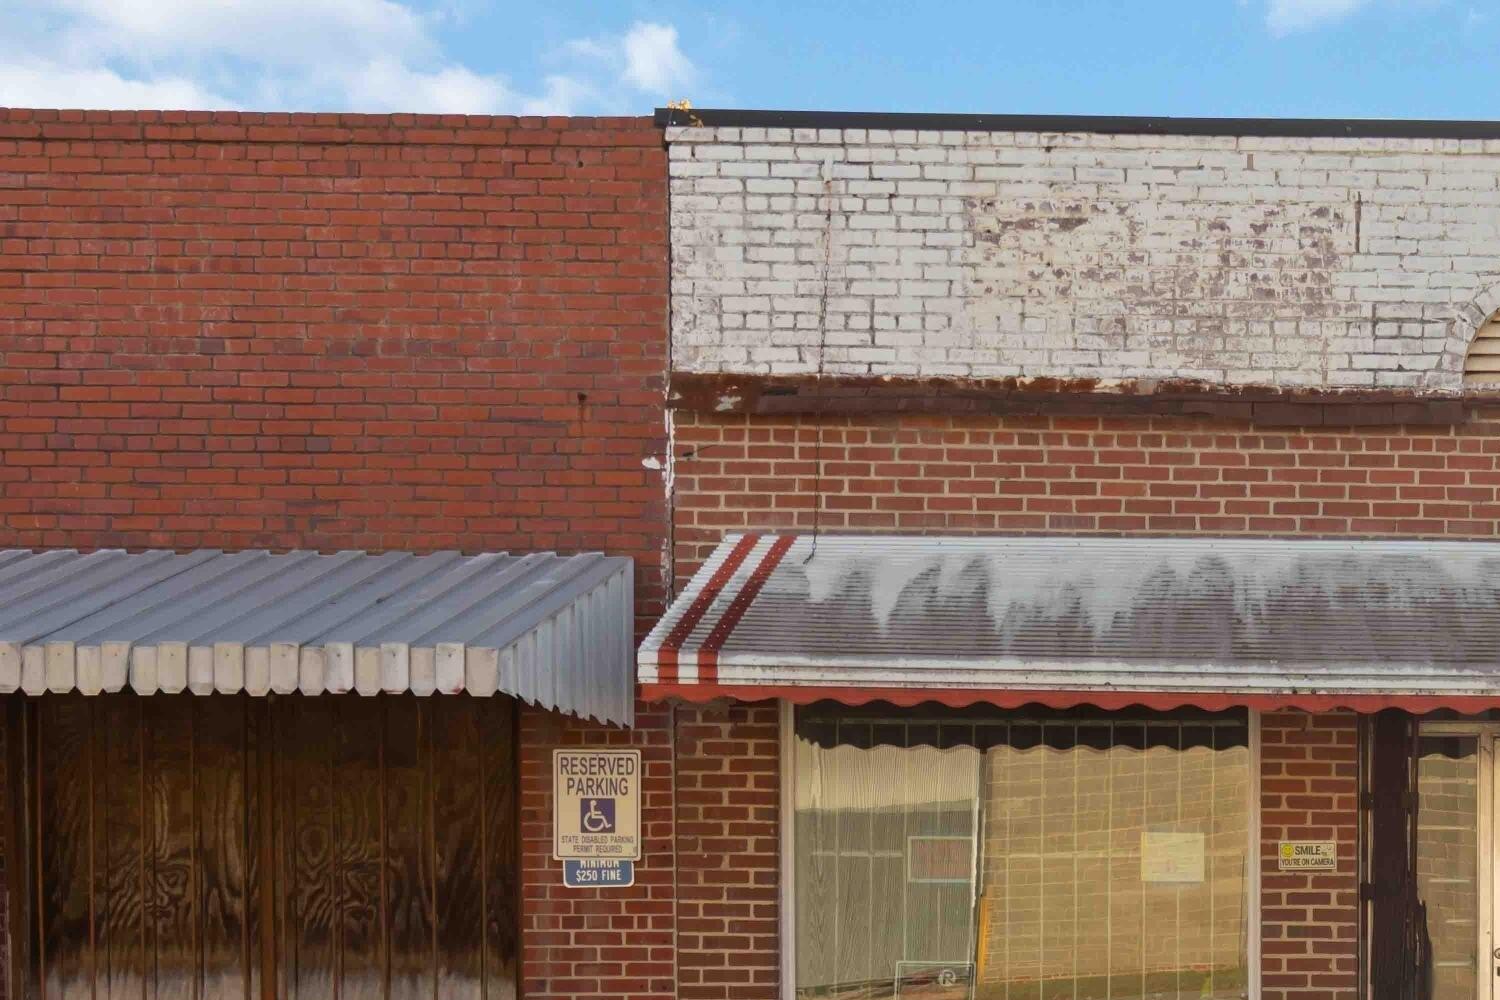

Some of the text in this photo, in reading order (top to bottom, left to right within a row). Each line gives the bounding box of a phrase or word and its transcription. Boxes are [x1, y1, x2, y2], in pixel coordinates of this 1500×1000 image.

[560, 756, 635, 776] RESERVED
[567, 777, 629, 796] PARKING
[561, 835, 634, 844] STATE DISABLED PARKING
[573, 845, 623, 853] PERMIT REQUIRED
[1294, 845, 1321, 856] SMILE
[580, 860, 620, 869] MINIMUM
[1281, 858, 1334, 866] YOU'RE ON CAMERA
[576, 869, 622, 883] $250 FINE
